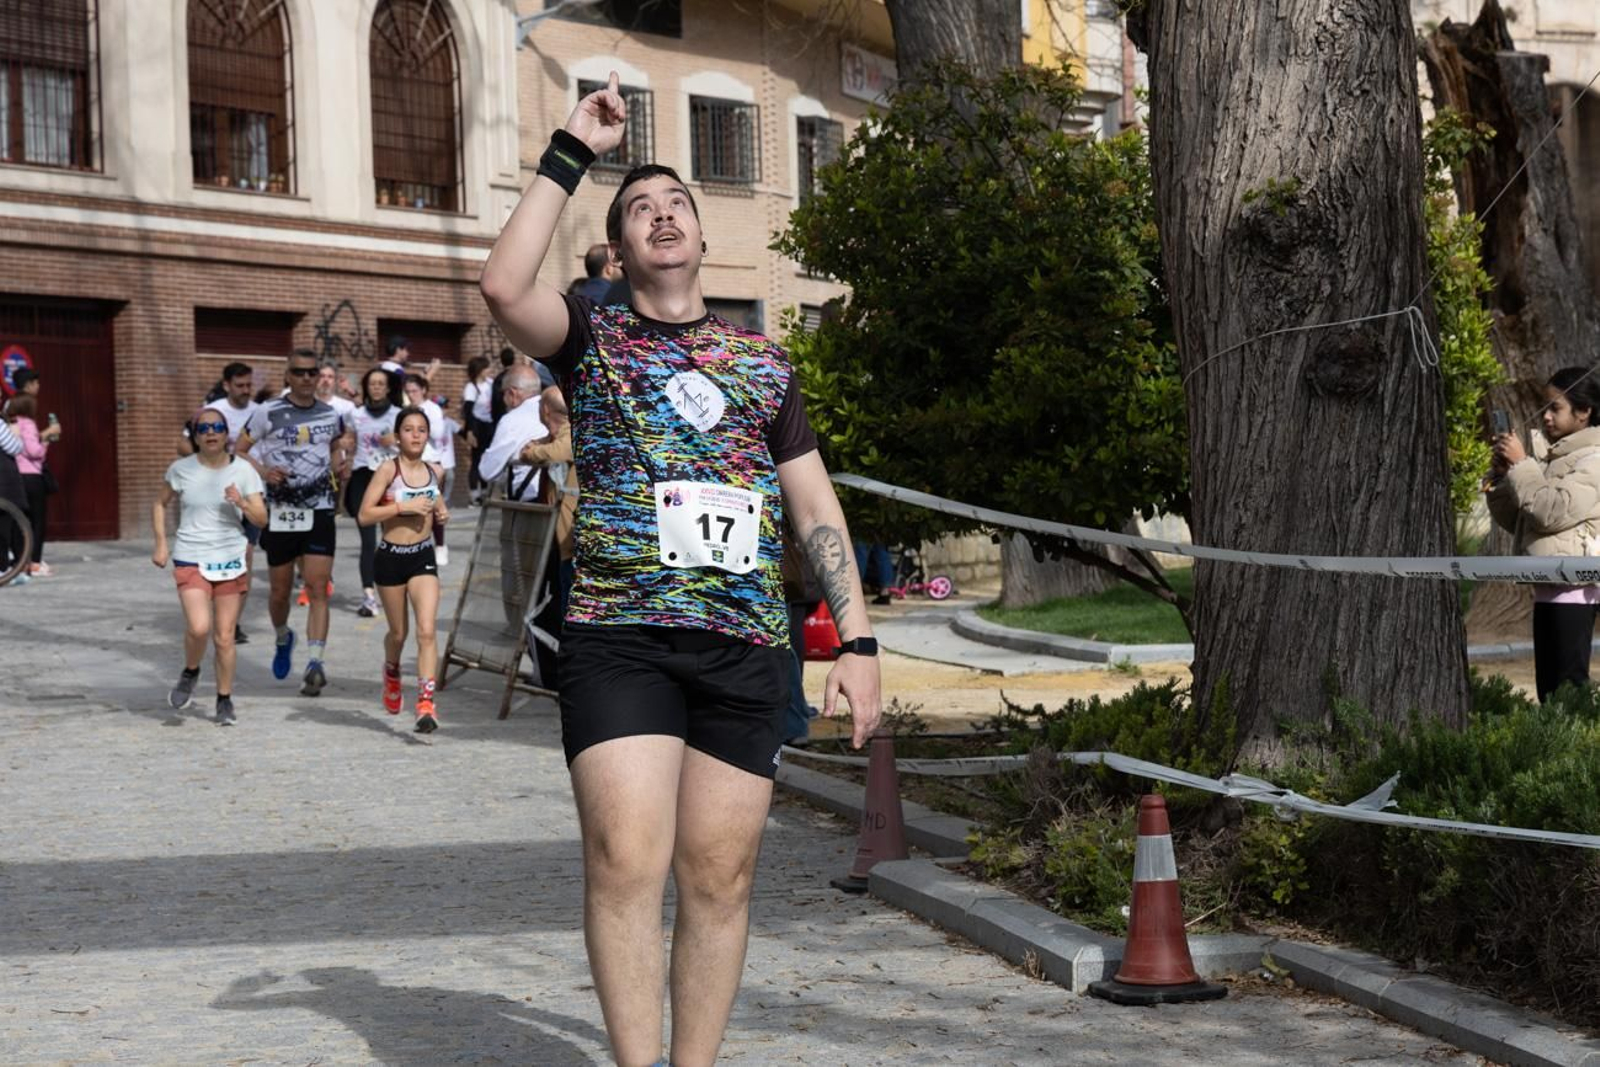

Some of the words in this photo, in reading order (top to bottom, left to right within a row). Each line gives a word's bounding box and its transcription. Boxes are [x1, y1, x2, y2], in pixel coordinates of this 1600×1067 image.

[279, 511, 305, 522] 434
[695, 513, 735, 543] 17
[390, 544, 420, 554] NIKE
[206, 557, 242, 570] 1125
